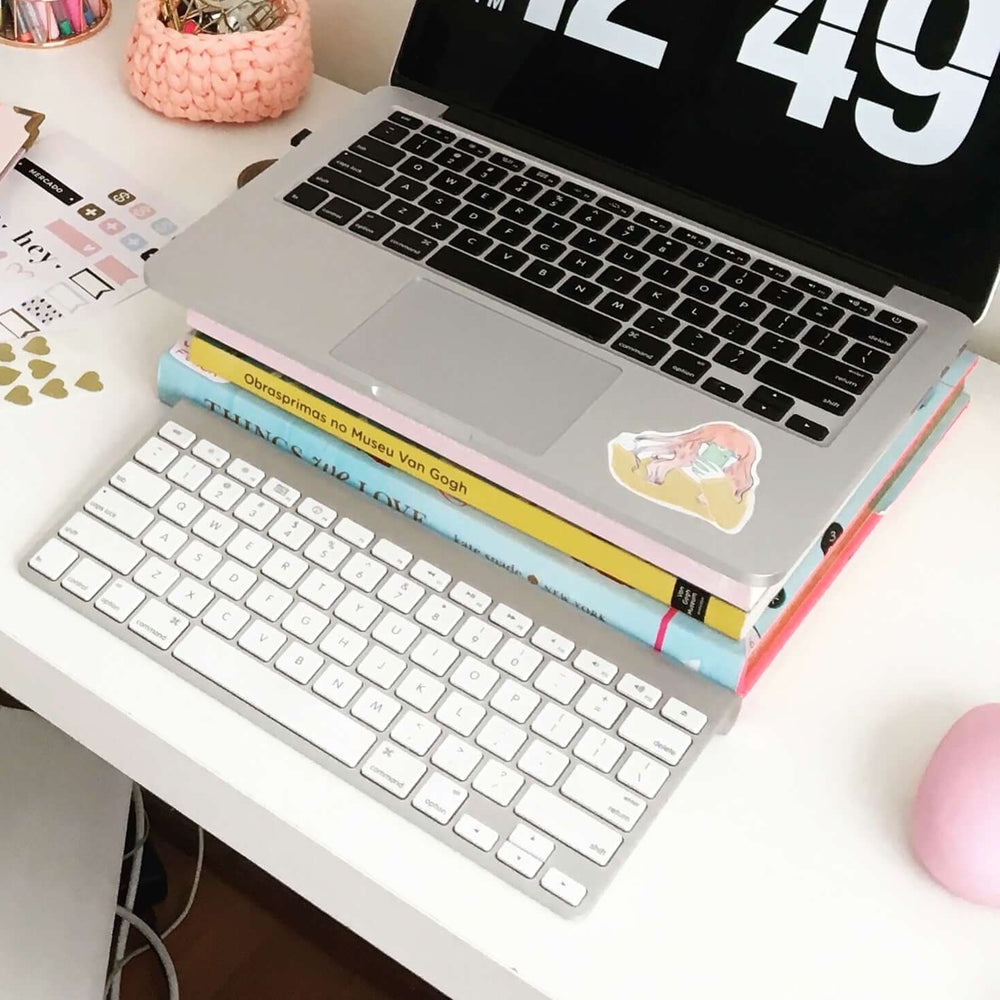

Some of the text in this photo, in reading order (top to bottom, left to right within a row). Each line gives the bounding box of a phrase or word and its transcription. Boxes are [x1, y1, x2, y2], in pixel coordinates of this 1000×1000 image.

[12, 229, 57, 265] hey
[28, 168, 64, 194] MERCADO
[400, 183, 410, 191] A
[434, 197, 444, 205] S
[468, 212, 479, 220] D
[539, 243, 551, 251] G
[575, 258, 587, 267] H
[651, 291, 663, 300] K
[691, 307, 698, 316] L
[412, 163, 424, 172] Q
[445, 176, 458, 186] W
[480, 192, 490, 200] E
[514, 206, 525, 215] R
[551, 221, 561, 229] T
[587, 236, 597, 245] Y
[622, 251, 635, 261] U
[698, 284, 710, 293] O
[738, 300, 750, 308] P
[397, 207, 408, 215] Z
[431, 221, 442, 230] X
[466, 237, 478, 245] C
[503, 252, 513, 260] V
[537, 268, 548, 277] B
[574, 284, 587, 293] N
[611, 300, 625, 310] M
[822, 397, 840, 408] shift
[618, 342, 654, 360] command
[671, 364, 695, 377] option
[244, 373, 468, 496] Obrasprimas no Museu Van Gogh
[834, 374, 858, 387] return
[150, 570, 163, 580] Z
[185, 590, 195, 600] X
[221, 611, 232, 622] C
[259, 633, 269, 643] V
[293, 655, 305, 666] B
[332, 678, 345, 690] N
[369, 700, 384, 713] M
[159, 533, 170, 543] A
[193, 552, 204, 563] S
[228, 572, 240, 583] D
[264, 594, 274, 602] F
[300, 615, 312, 626] G
[337, 637, 350, 648] H
[376, 661, 387, 671] J
[415, 682, 427, 694] K
[455, 706, 464, 718] L
[176, 501, 187, 512] Q
[208, 519, 223, 531] W
[244, 540, 255, 551] E
[280, 561, 291, 571] R
[316, 582, 326, 591] T
[354, 603, 364, 613] Y
[390, 624, 403, 636] U
[468, 670, 481, 681] O
[509, 693, 521, 703] P
[136, 619, 167, 641] command
[369, 765, 405, 789] command
[425, 799, 447, 815] option
